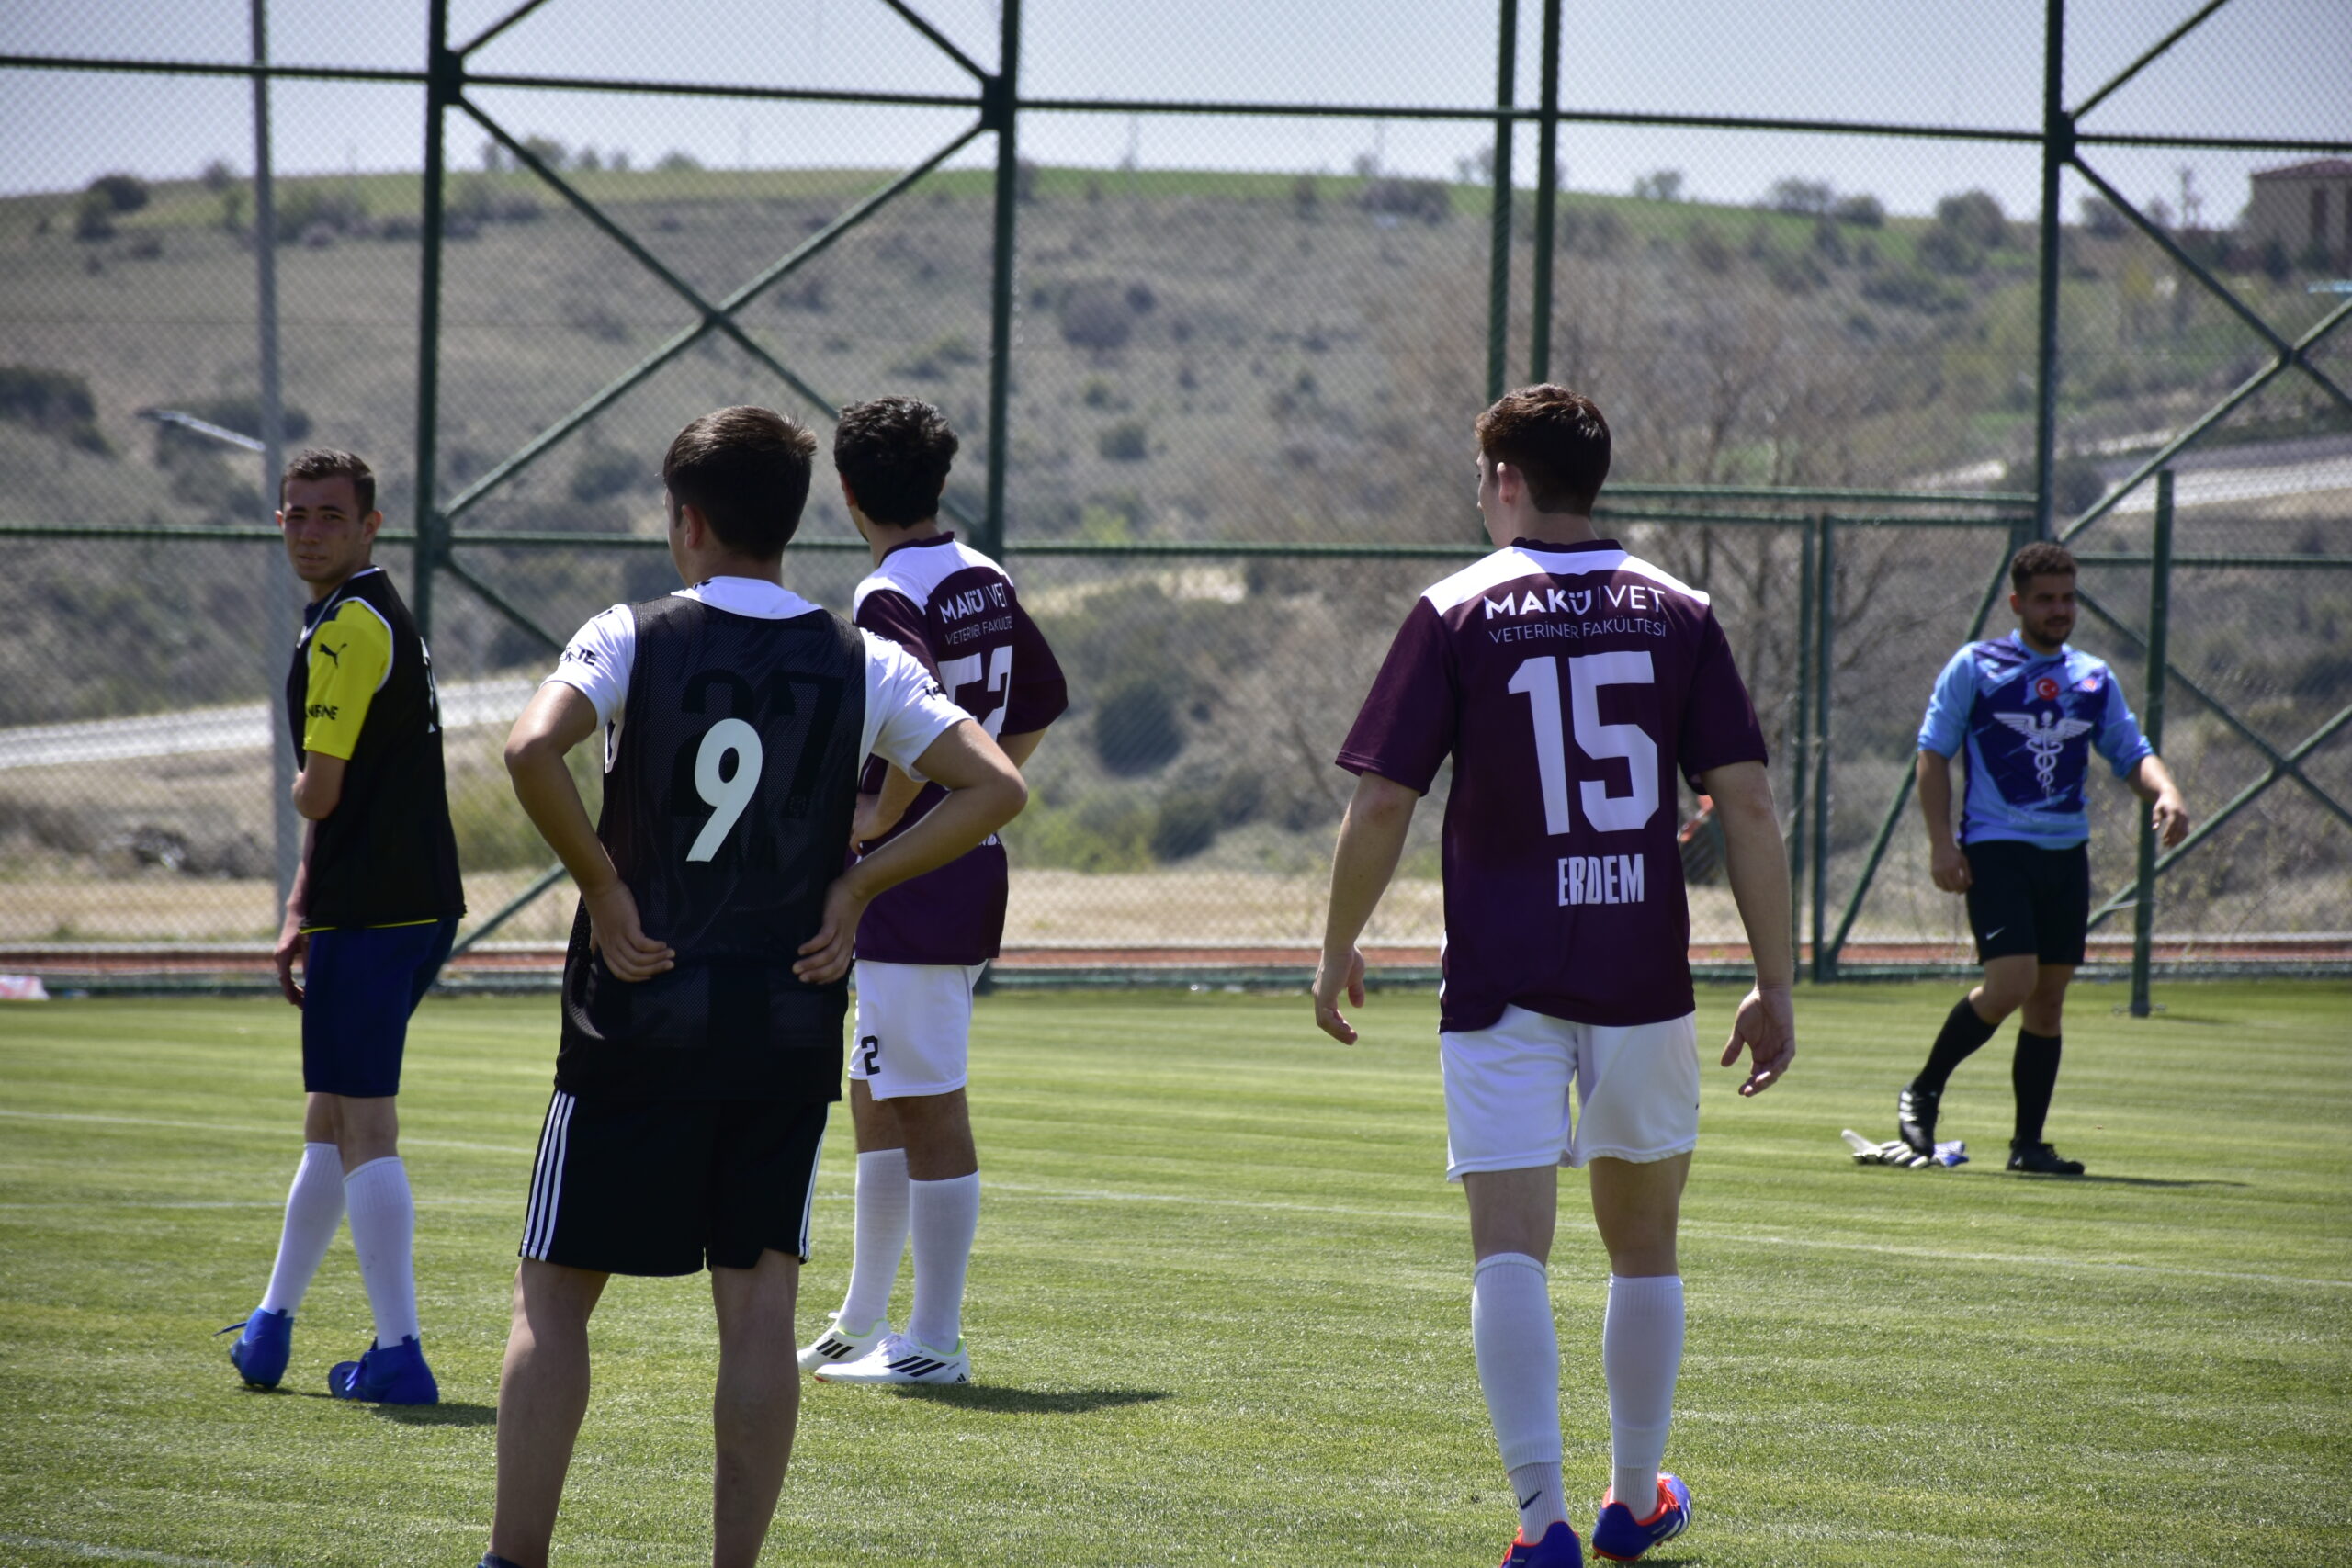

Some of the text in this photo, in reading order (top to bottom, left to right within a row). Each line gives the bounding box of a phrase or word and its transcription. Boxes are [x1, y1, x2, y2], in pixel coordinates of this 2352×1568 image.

[986, 582, 1007, 608] VET
[1483, 584, 1666, 620] MAKÜ VET
[1488, 615, 1667, 644] VETERİNER FAKÜLTESİ
[1507, 650, 1660, 836] 15
[685, 717, 763, 863] 9
[1557, 853, 1645, 908] ERDEM
[861, 1035, 881, 1077] 2
